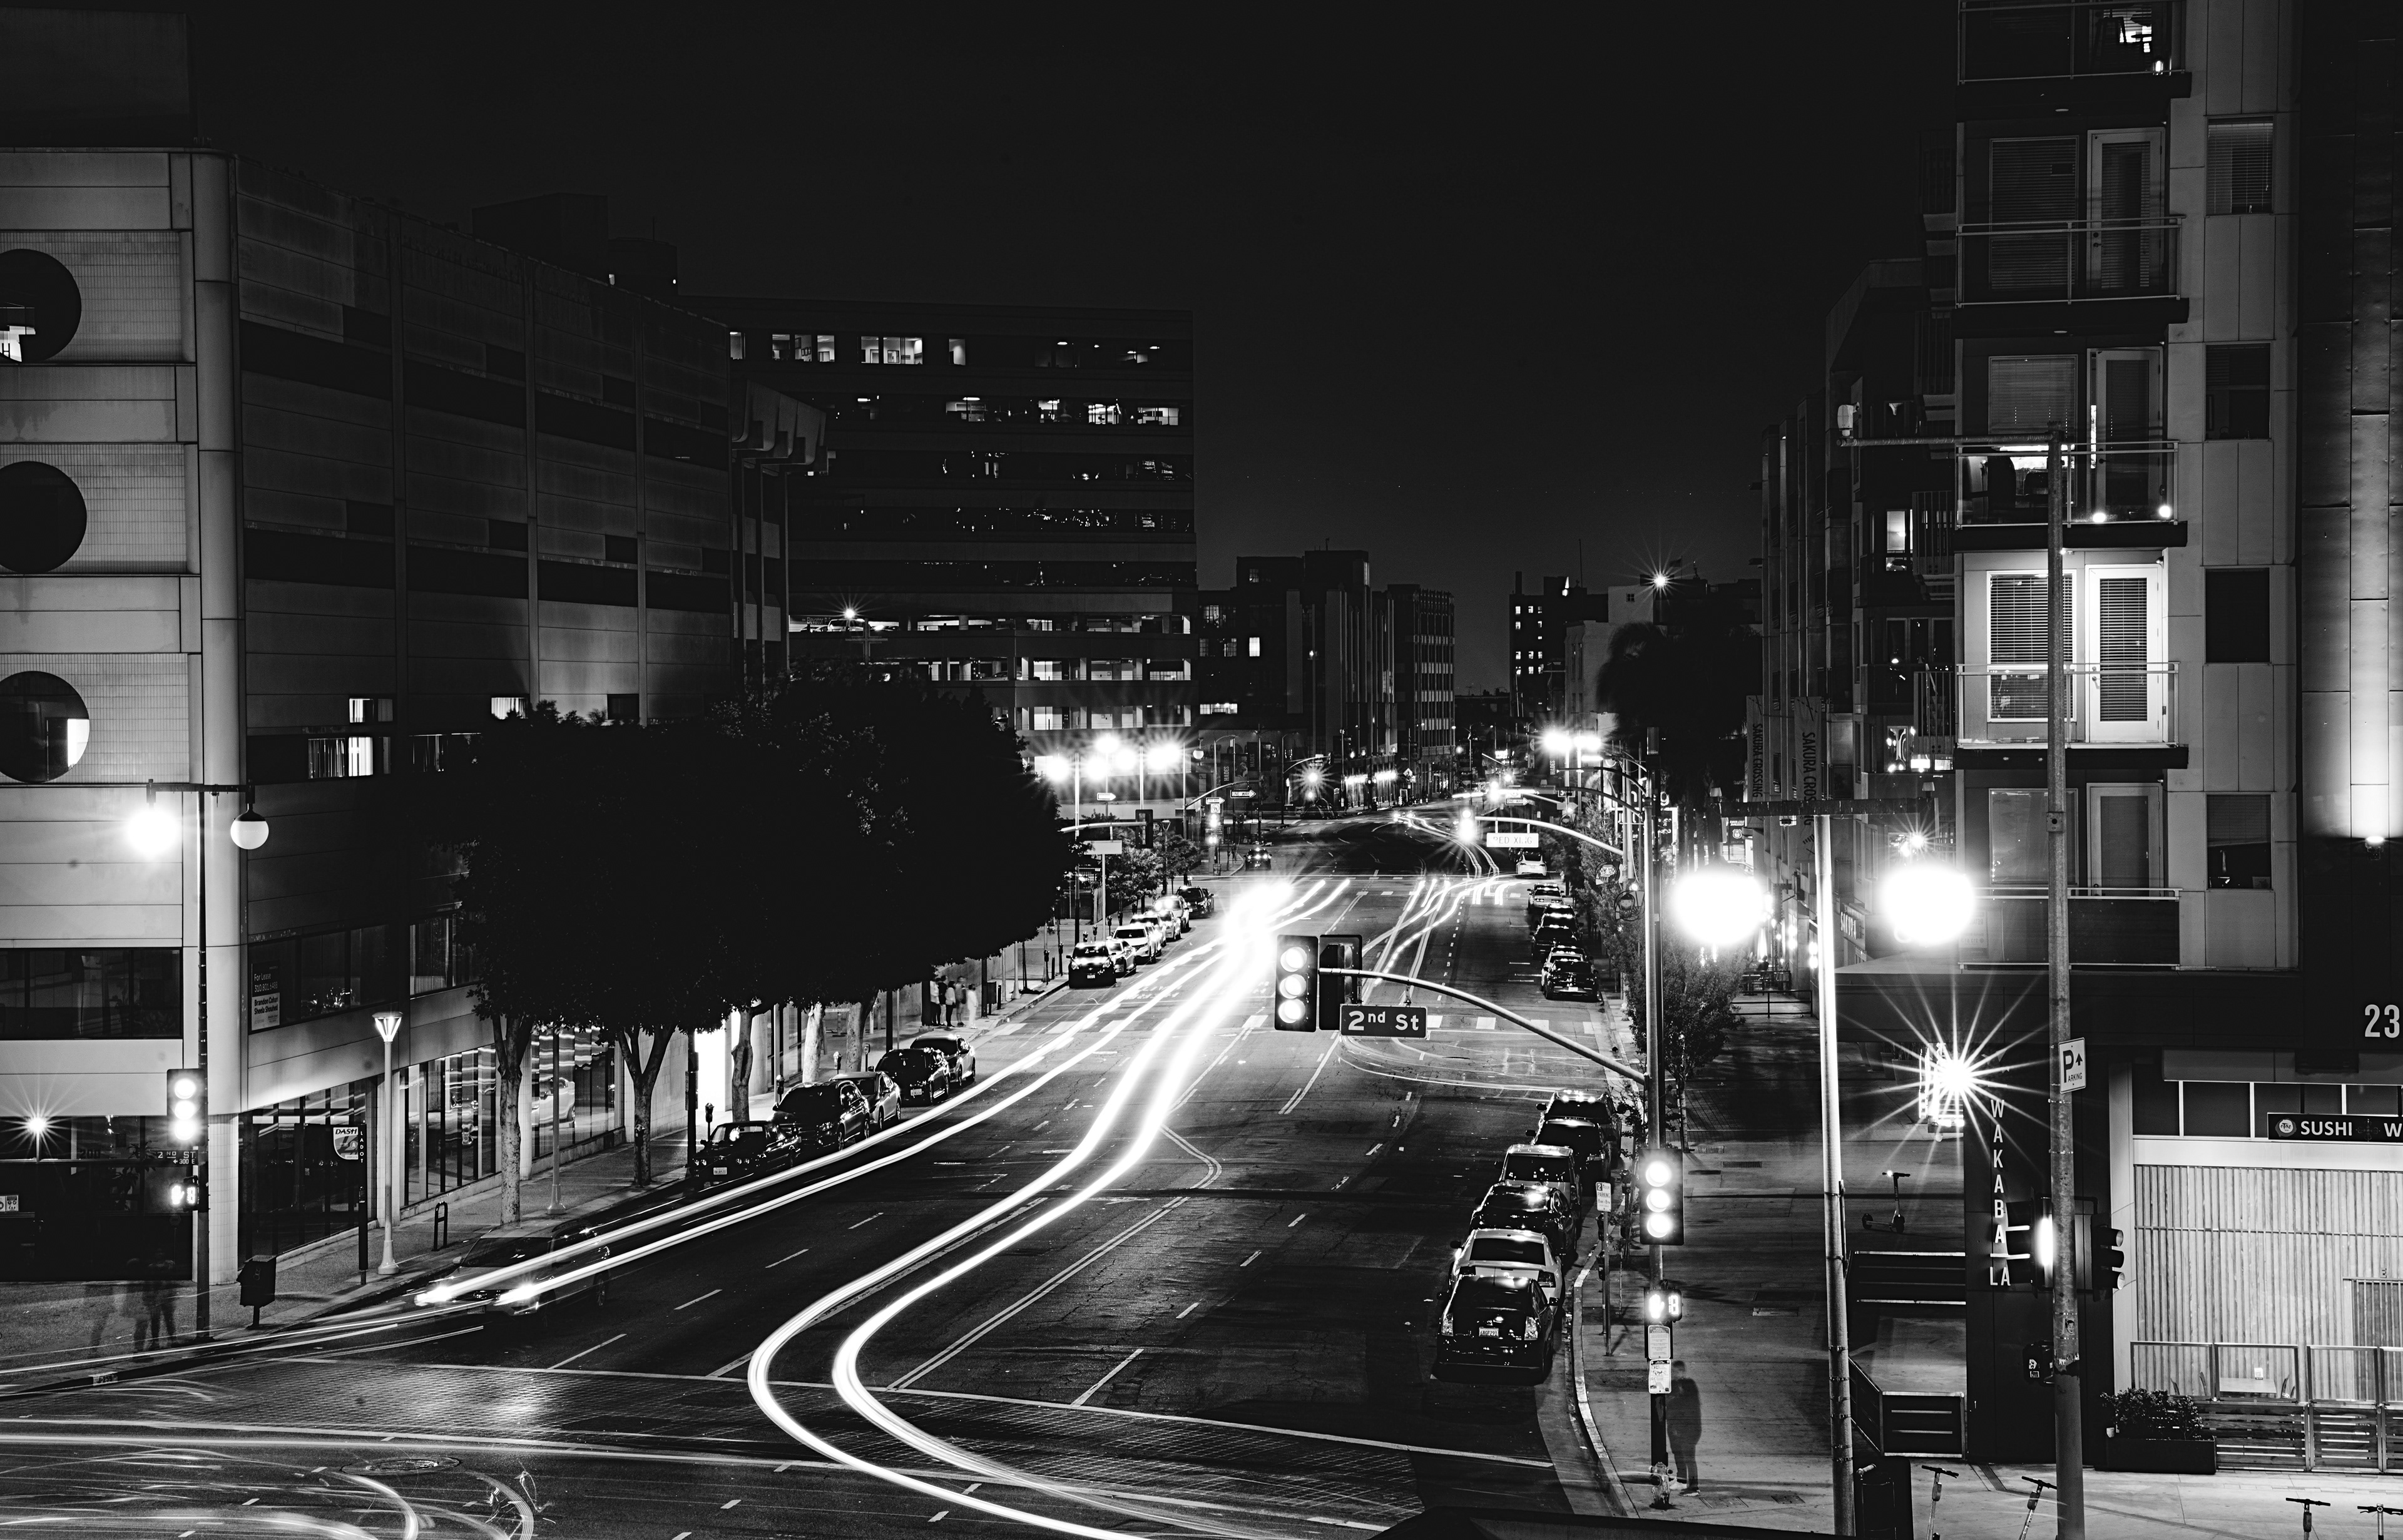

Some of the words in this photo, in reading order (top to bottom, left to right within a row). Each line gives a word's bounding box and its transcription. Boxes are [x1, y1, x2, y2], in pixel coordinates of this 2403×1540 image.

[807, 616, 824, 625] Elevator
[1752, 723, 1763, 757] SAKURA
[1802, 732, 1817, 773] SAKURA
[1752, 758, 1763, 798] CROSSING
[1803, 776, 1817, 826] CROSG
[261, 972, 271, 981] Lease
[254, 998, 268, 1006] Brandon
[254, 1006, 265, 1015] Sheela
[1348, 1010, 1386, 1031] 2nd
[1395, 1014, 1419, 1031] St
[2364, 1004, 2400, 1038] 23
[2300, 1120, 2353, 1136] SUSHI
[2383, 1122, 2403, 1138] W
[1990, 1099, 2006, 1244] WAKABA
[1989, 1267, 2011, 1287] LA
